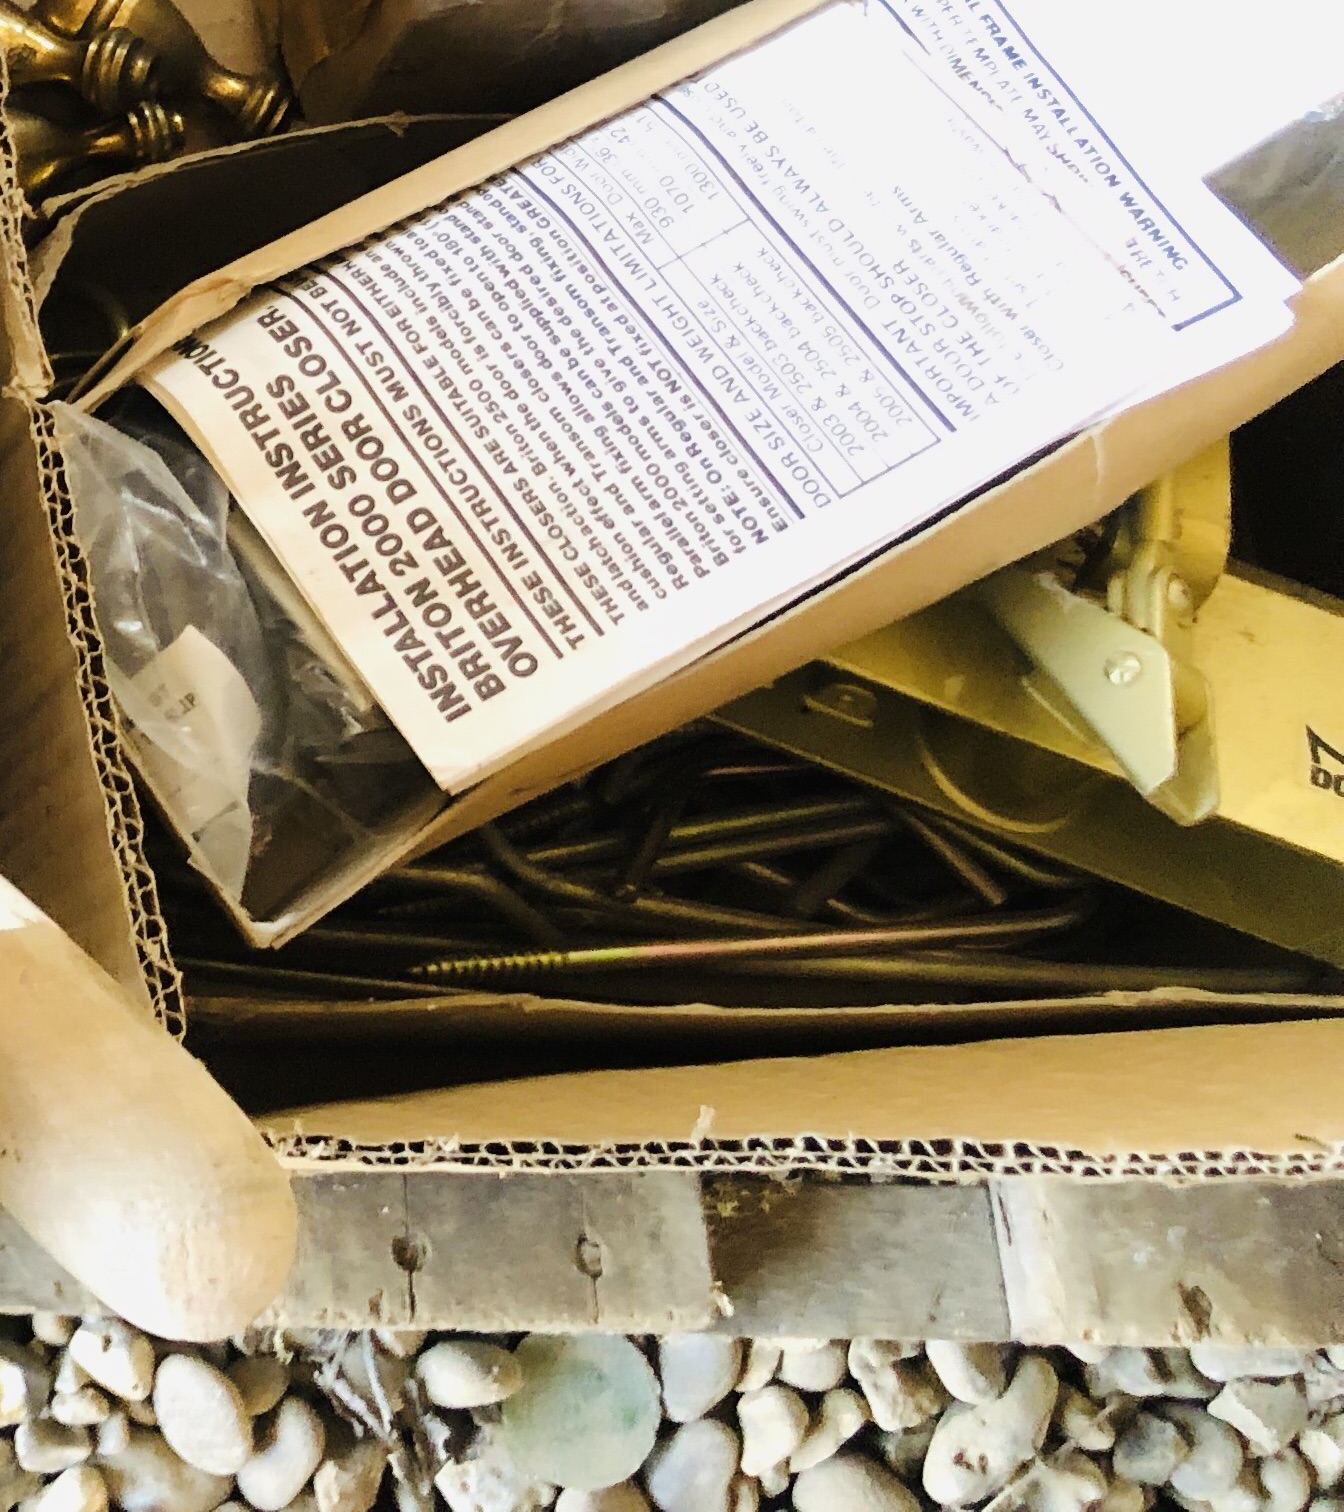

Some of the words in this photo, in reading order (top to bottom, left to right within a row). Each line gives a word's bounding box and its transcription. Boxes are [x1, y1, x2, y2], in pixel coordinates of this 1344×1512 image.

[741, 117, 771, 146] BE
[979, 13, 1027, 68] FRAME
[1023, 72, 1121, 187] INSTALLATION
[1119, 191, 1187, 270] WARNING
[527, 151, 561, 184] FOR
[684, 163, 718, 199] 1300
[766, 145, 829, 212] ALWAYS
[454, 192, 493, 229] stand
[487, 198, 527, 233] stand
[644, 196, 674, 228] 930
[658, 175, 694, 213] 1070
[888, 183, 930, 227] Arms
[410, 234, 432, 253] to
[443, 214, 481, 244] stand
[489, 228, 526, 264] door
[560, 183, 656, 290] LIMITATIONS
[622, 209, 655, 246] Max
[378, 231, 428, 282] thrown
[423, 249, 461, 286] fixed
[459, 253, 482, 275] to
[476, 242, 513, 281] with
[529, 232, 566, 282] fixing,
[548, 229, 606, 294] position
[828, 218, 894, 289] SHOULD
[928, 230, 981, 286] Regular
[350, 267, 402, 318] EITHER
[379, 263, 427, 313] include
[456, 285, 482, 313] be
[472, 268, 512, 315] open
[518, 263, 572, 326] desired
[597, 293, 620, 315] at
[892, 258, 958, 328] CLOSER
[978, 284, 1020, 324] with
[320, 299, 361, 336] NOT
[425, 282, 476, 344] forcibly
[472, 306, 505, 343] can
[503, 278, 561, 345] supplied
[503, 310, 525, 334] to
[565, 283, 621, 356] Transom
[651, 295, 714, 363] WEIGHT
[694, 296, 729, 334] Size
[710, 273, 777, 351] backcheck
[890, 293, 935, 336] STOP
[396, 317, 428, 354] FOR
[425, 315, 473, 375] models
[470, 341, 491, 363] is
[517, 331, 555, 372] door
[567, 324, 598, 357] the
[613, 314, 652, 355] fixed
[723, 331, 743, 350] &
[822, 325, 860, 365] 2505
[954, 328, 993, 369] THE
[256, 305, 352, 413] CLOSER.
[354, 341, 409, 402] MUST
[500, 341, 549, 402] closers
[556, 344, 581, 371] be
[591, 354, 628, 395] give
[617, 355, 648, 385] and
[647, 359, 681, 393] NOT
[738, 352, 781, 400] Model
[771, 352, 812, 393] 2503
[796, 340, 836, 377] 2504
[857, 365, 877, 385] &
[882, 319, 979, 419] IMPORTANT
[932, 337, 984, 391] DOOR
[422, 354, 489, 438] SUITABLE
[468, 378, 508, 423] 2500
[482, 360, 521, 403] door
[551, 371, 594, 423] allows
[573, 366, 605, 401] can
[619, 392, 641, 415] to
[676, 391, 697, 412] is
[711, 364, 749, 402] AND
[808, 394, 828, 413] &
[831, 380, 853, 400] &
[513, 400, 543, 433] the
[646, 390, 702, 457] Regular
[847, 401, 888, 441] 2004
[874, 387, 912, 424] 2005
[266, 374, 356, 489] SERIES
[505, 423, 547, 476] Briton
[549, 406, 607, 482] Transom
[593, 425, 632, 474] fixing
[601, 401, 651, 461] models
[638, 415, 676, 459] arms
[692, 414, 738, 465] closer
[746, 408, 784, 450] SIZE
[781, 404, 823, 452] Closer
[822, 413, 864, 456] 2003
[340, 412, 417, 505] DOOR
[483, 438, 518, 473] ARE
[538, 430, 575, 477] when
[696, 455, 724, 486] On
[402, 404, 529, 570] INSTRUCTIONS
[603, 482, 634, 515] and
[627, 473, 662, 513] arm
[645, 462, 688, 511] 2000
[674, 461, 724, 524] setting
[737, 469, 788, 532] Ensure
[780, 451, 831, 508] DOOR
[513, 477, 578, 560] CLOSERS
[548, 476, 592, 536] action.
[571, 477, 615, 529] effect
[721, 484, 769, 543] NOTE:
[347, 493, 419, 576] 2000
[631, 520, 689, 590] Regular
[653, 511, 710, 578] Parallel
[684, 510, 729, 566] Briton
[719, 525, 748, 556] for
[588, 536, 623, 580] latch
[612, 531, 666, 599] cushion
[302, 499, 471, 722] INSTALLATION
[406, 507, 538, 677] OVERHEAD
[521, 570, 584, 650] THESE
[573, 562, 624, 625] THESE
[616, 579, 648, 611] and
[403, 576, 506, 701] BRITON
